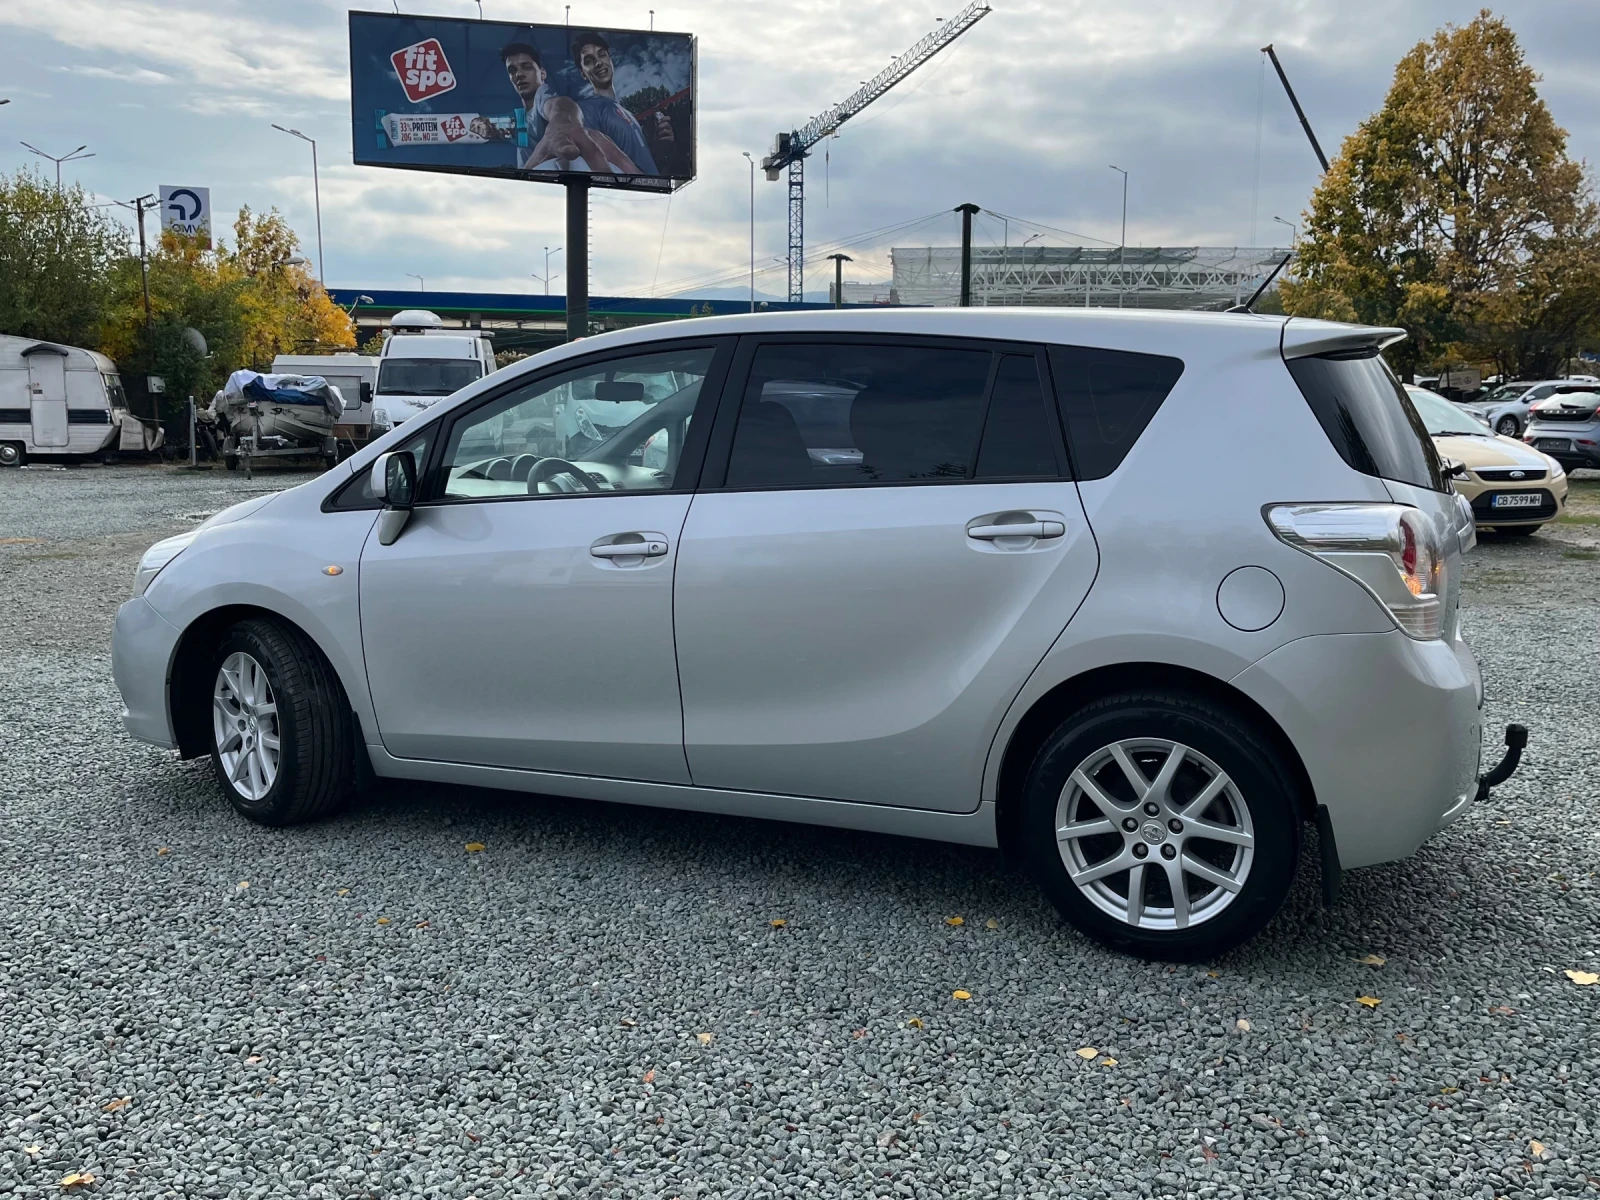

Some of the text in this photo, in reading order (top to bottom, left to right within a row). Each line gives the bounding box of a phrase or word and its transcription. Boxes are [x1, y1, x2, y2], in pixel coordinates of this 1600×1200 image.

[404, 46, 437, 71] fit
[405, 69, 453, 92] spo
[400, 122, 438, 132] 33% PROTEIN
[445, 118, 461, 129] fit
[446, 127, 467, 138] spo
[172, 223, 200, 234] OMV
